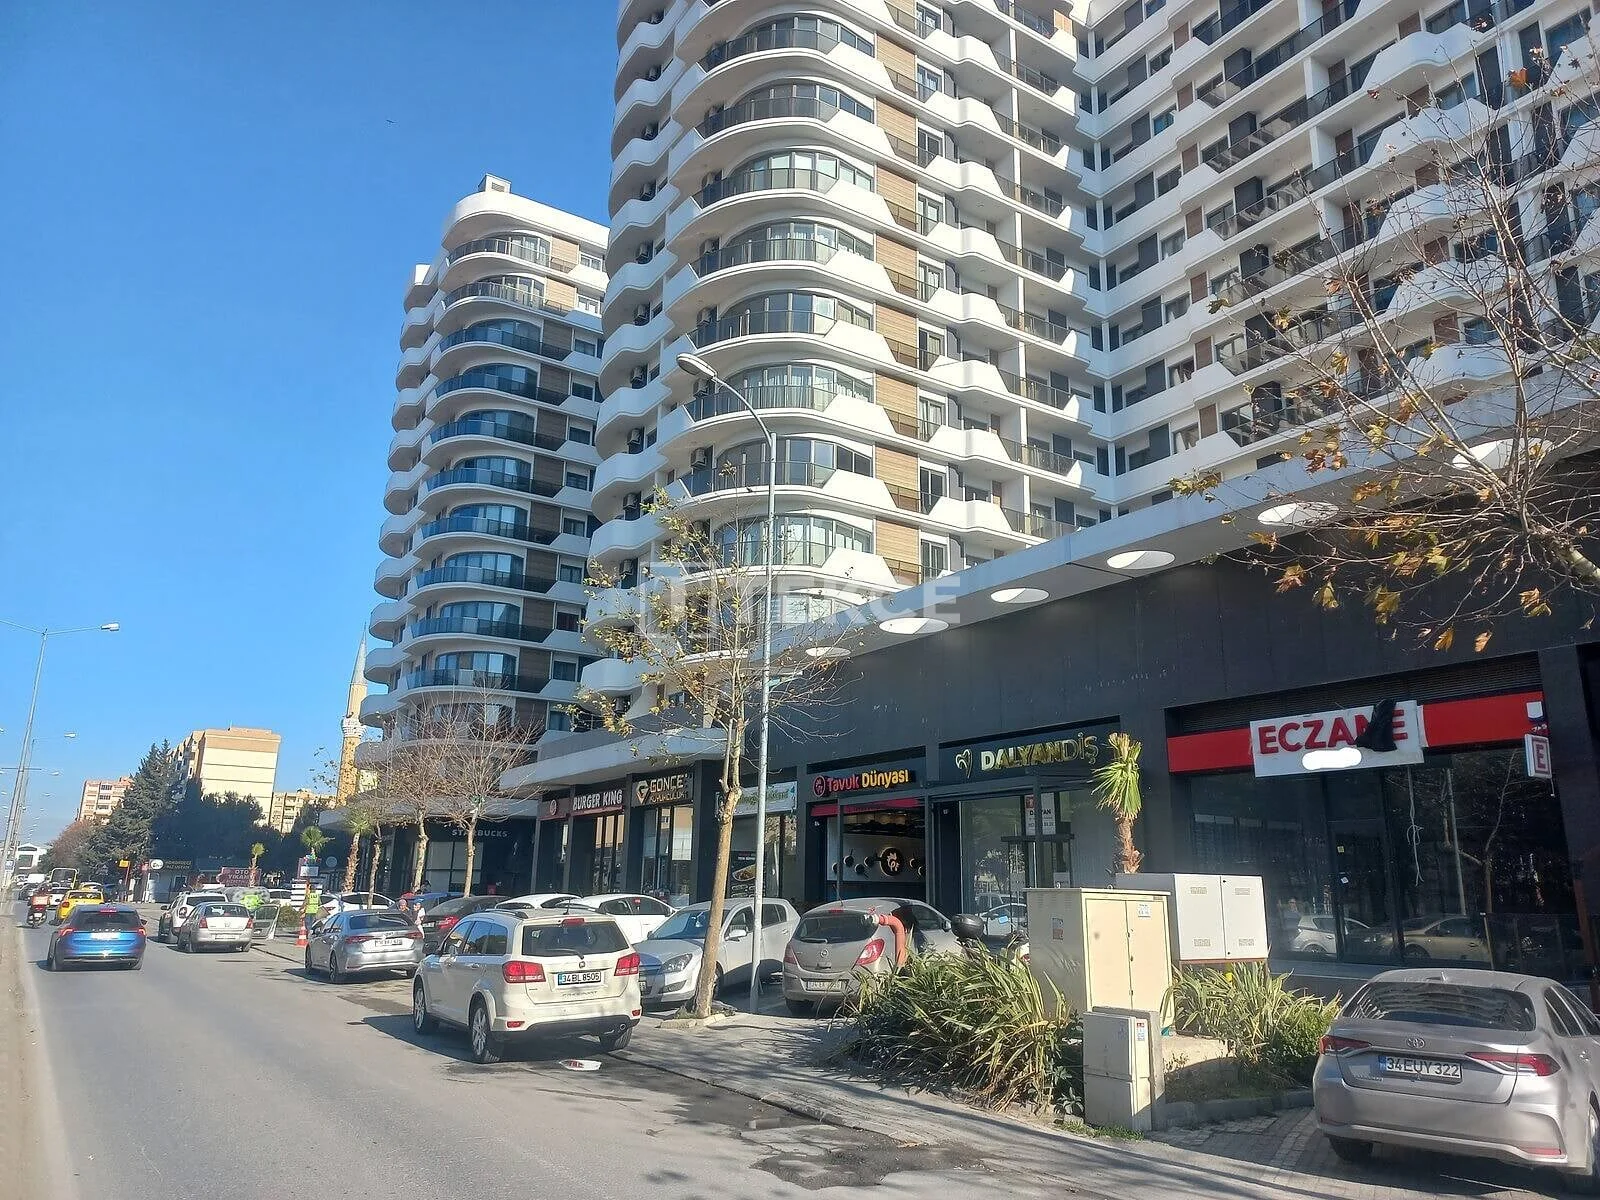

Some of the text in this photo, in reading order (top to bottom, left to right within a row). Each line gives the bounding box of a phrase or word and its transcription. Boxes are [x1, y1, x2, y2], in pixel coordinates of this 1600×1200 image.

[828, 769, 909, 792] Tavuk Dünyası
[573, 789, 623, 811] BURGER KING
[451, 829, 508, 838] STABUCKS
[1403, 1058, 1433, 1074] EUY
[1434, 1063, 1460, 1077] 322
